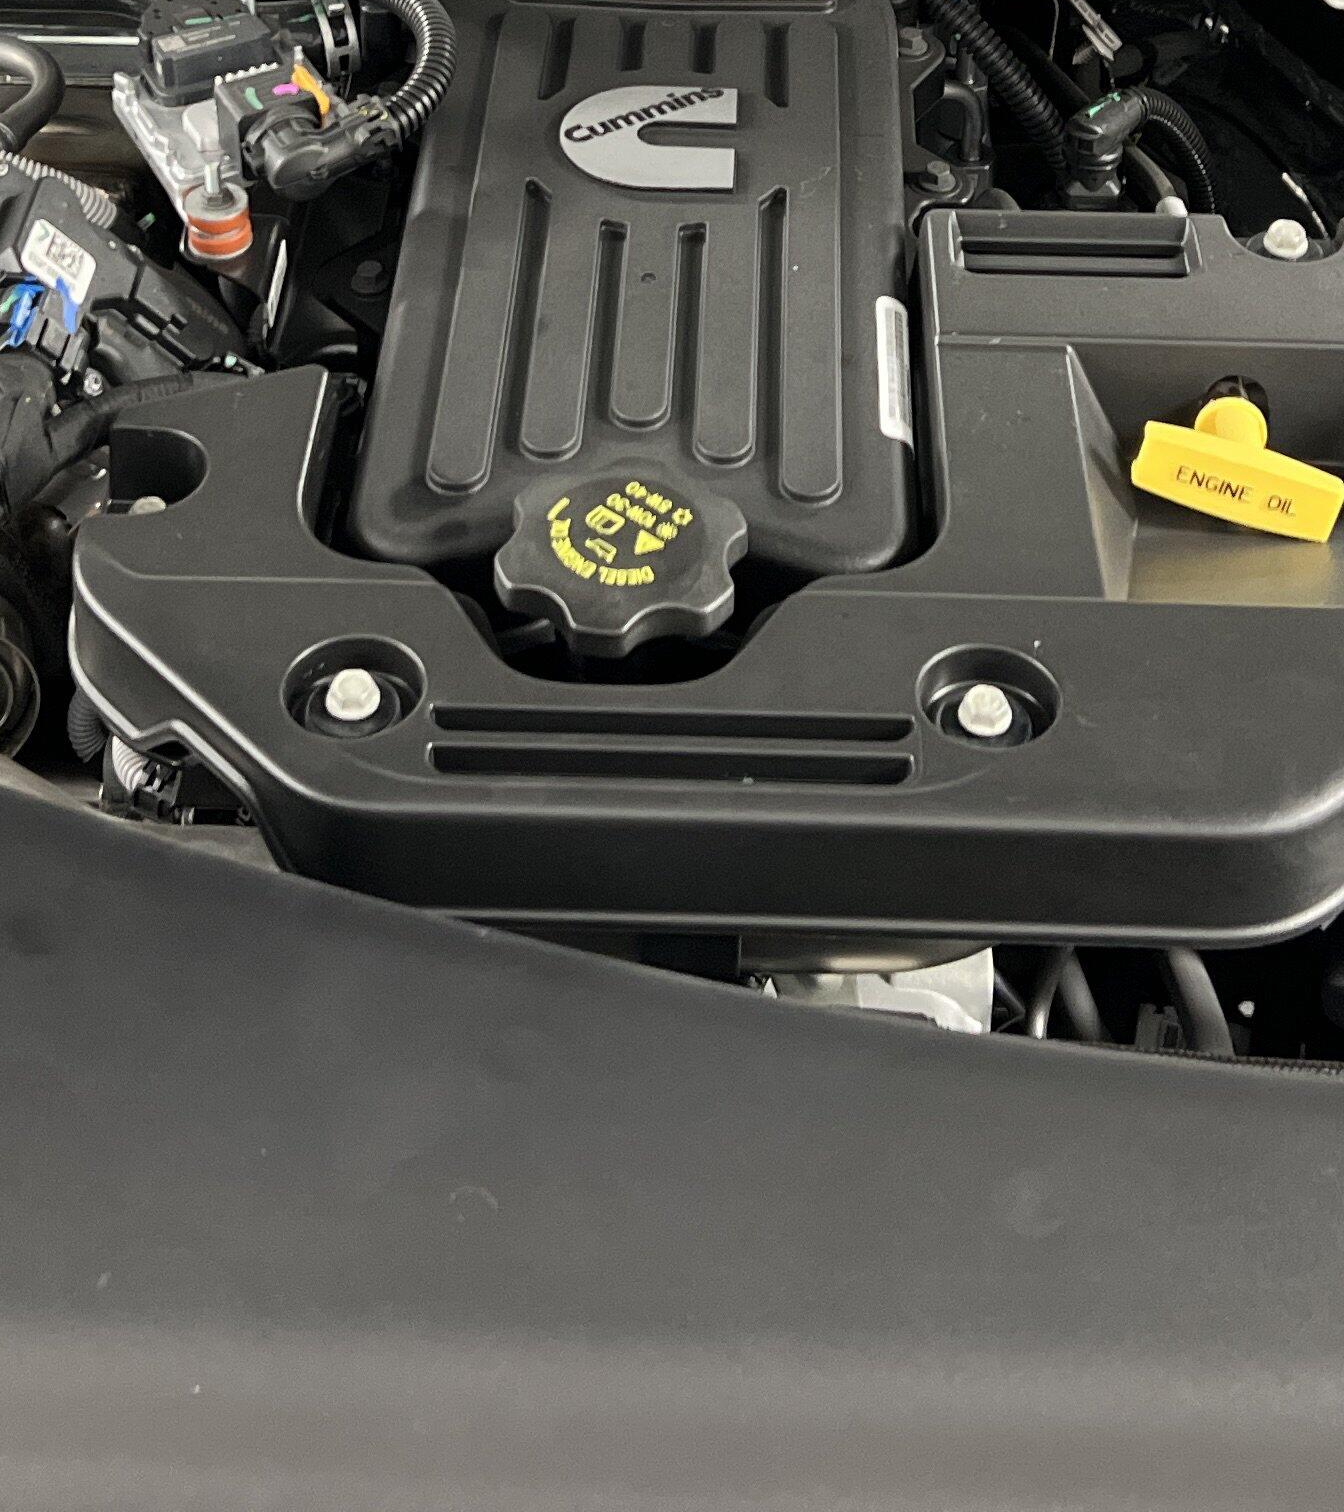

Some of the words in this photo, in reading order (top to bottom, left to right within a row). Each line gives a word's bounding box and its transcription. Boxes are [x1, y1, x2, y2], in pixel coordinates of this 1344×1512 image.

[564, 86, 725, 143] Cummins
[1176, 465, 1255, 504] ENGINE
[1267, 494, 1297, 518] OIL
